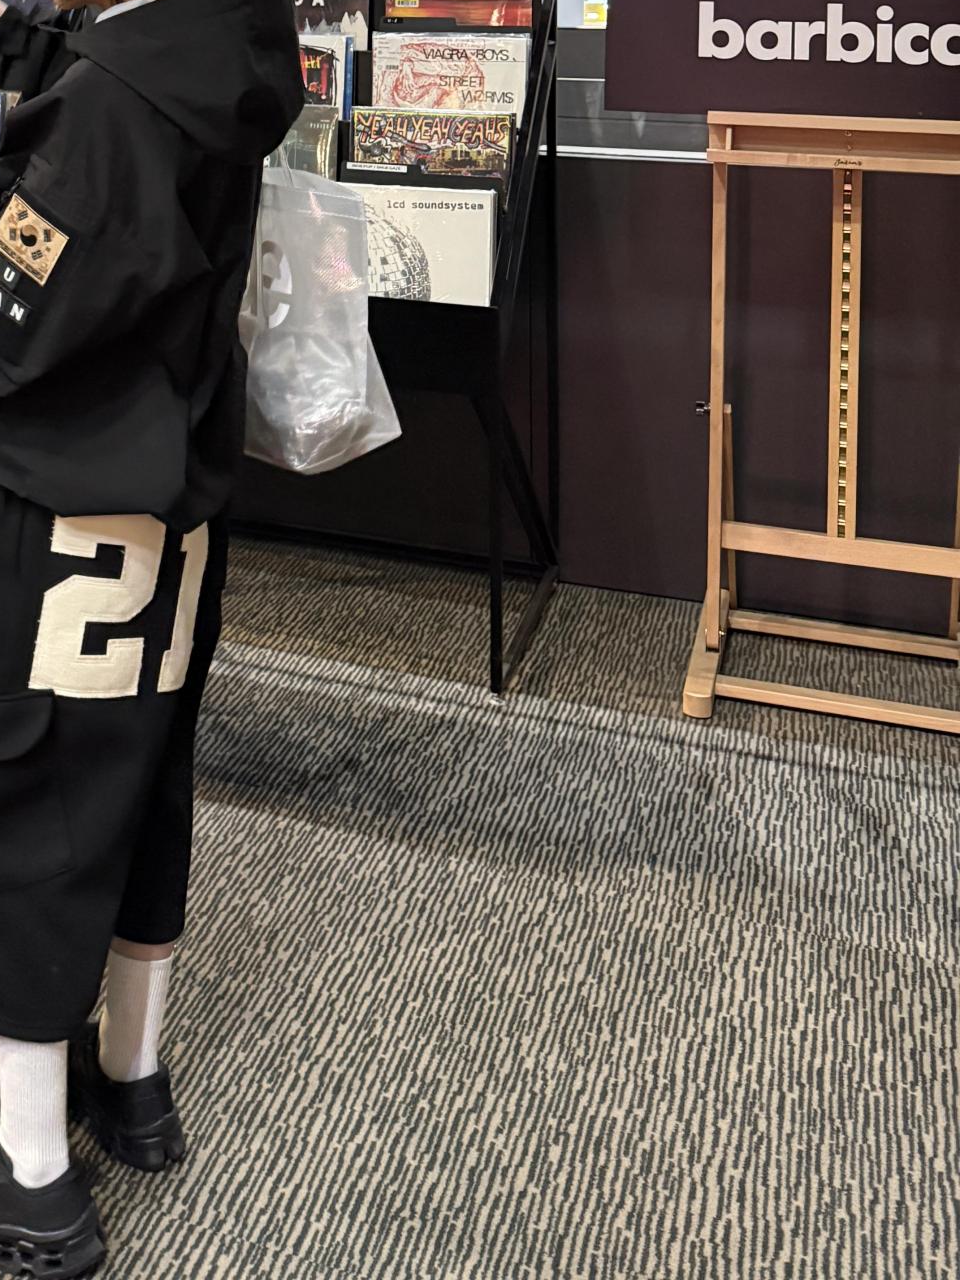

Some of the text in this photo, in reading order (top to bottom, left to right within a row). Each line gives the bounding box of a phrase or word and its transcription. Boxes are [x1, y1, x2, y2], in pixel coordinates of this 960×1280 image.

[423, 49, 509, 60] VIAGRA BOYS
[440, 75, 484, 87] STREET
[357, 112, 408, 143] YEAH
[412, 116, 452, 141] YEAH
[456, 116, 510, 143] YEAHS
[387, 200, 484, 211] lcd soundsystem
[28, 514, 209, 698] 21
